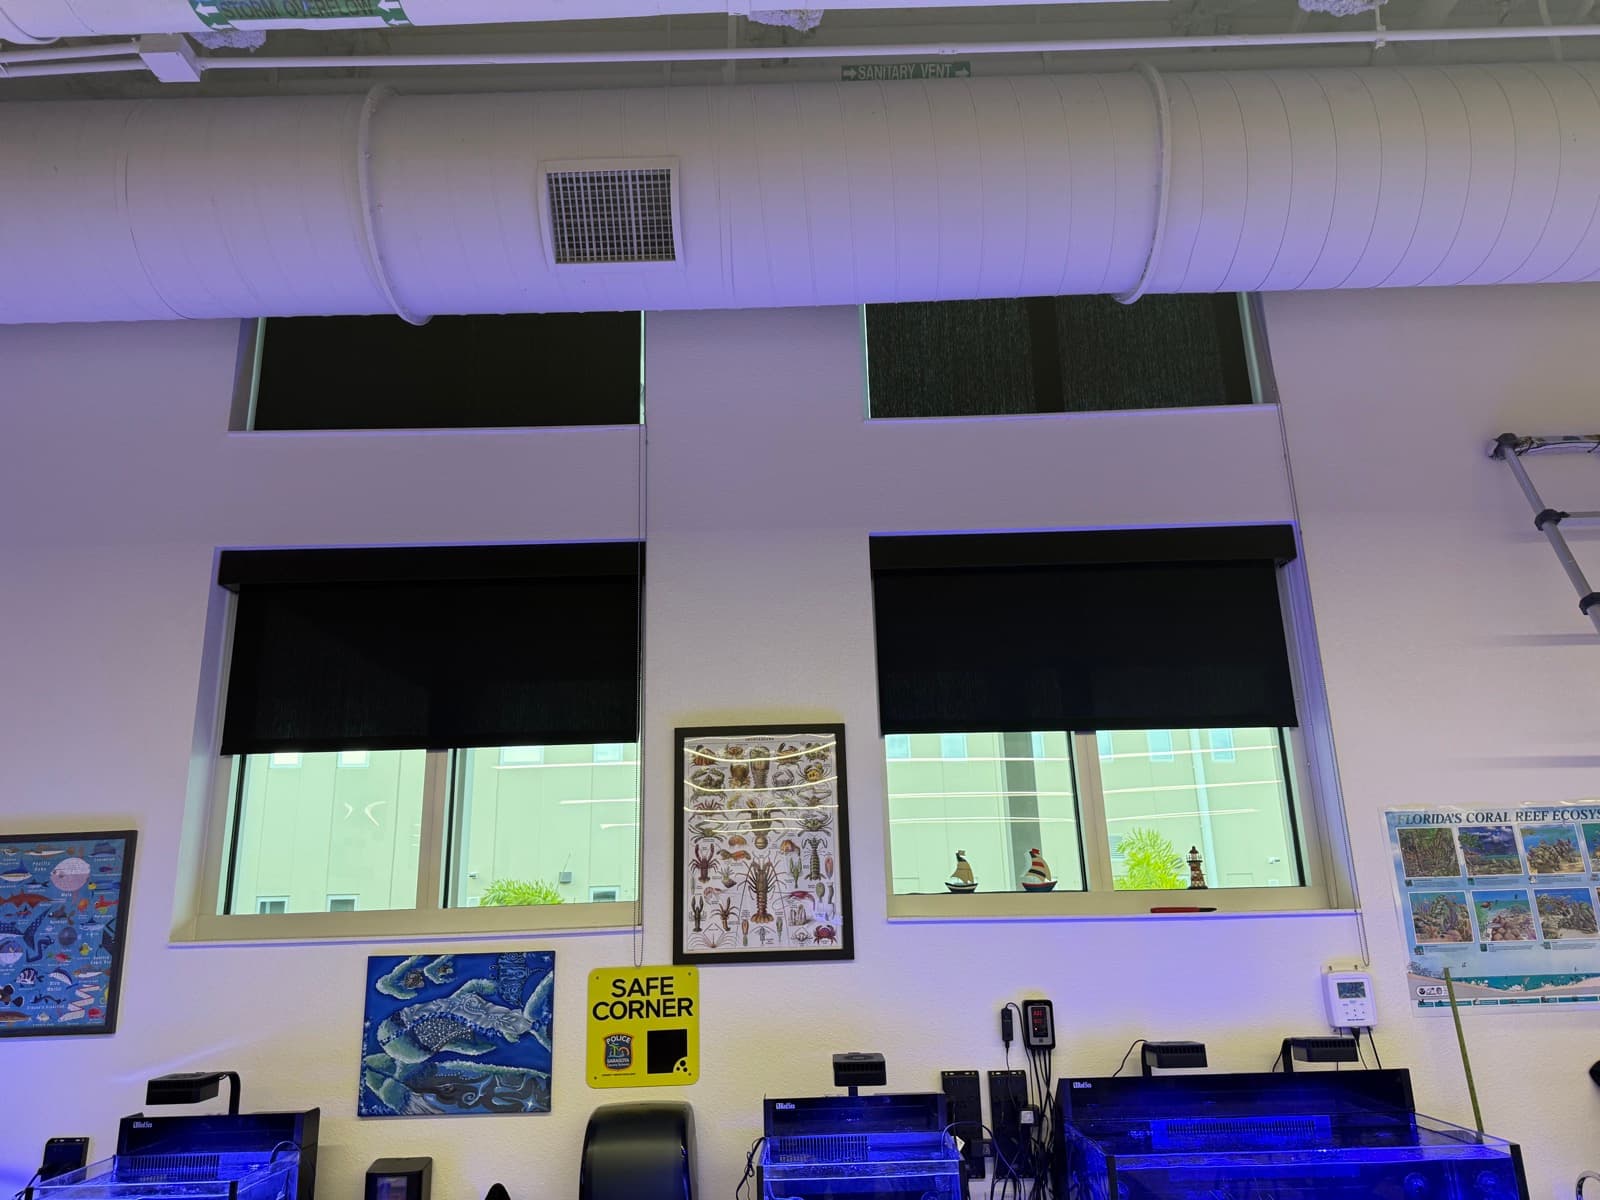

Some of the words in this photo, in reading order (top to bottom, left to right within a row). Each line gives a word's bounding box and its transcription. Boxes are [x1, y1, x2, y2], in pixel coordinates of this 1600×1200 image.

[220, 0, 279, 17] STORM
[857, 64, 914, 80] SANITARY
[920, 63, 952, 79] VENT
[1397, 812, 1462, 825] FLORIDA'S
[1466, 811, 1511, 823] CORAL
[1515, 810, 1549, 822] REEF
[611, 976, 674, 998] SAFE
[592, 997, 694, 1021] CORNER
[606, 1035, 631, 1045] POLICE
